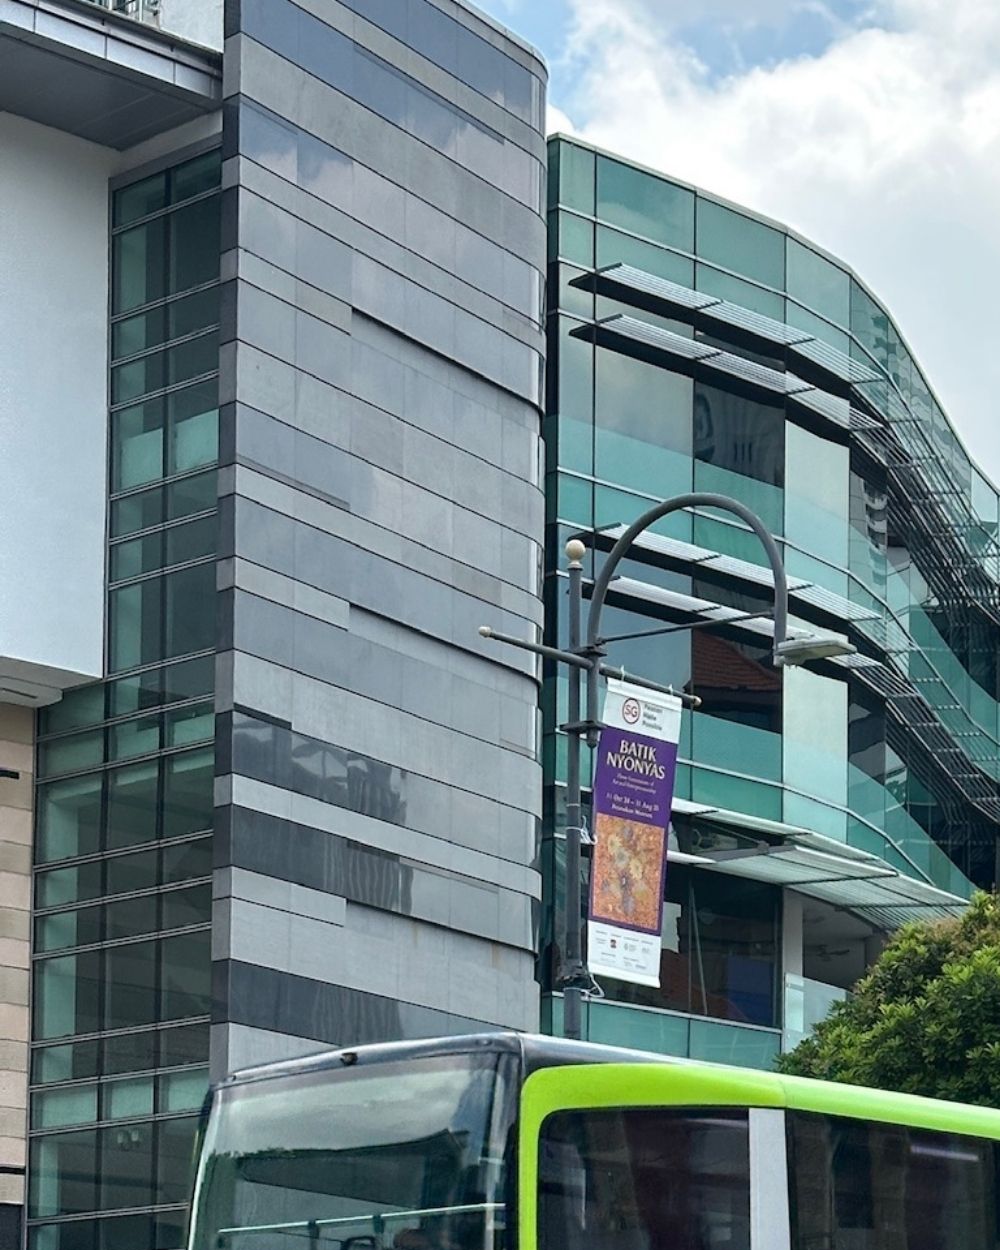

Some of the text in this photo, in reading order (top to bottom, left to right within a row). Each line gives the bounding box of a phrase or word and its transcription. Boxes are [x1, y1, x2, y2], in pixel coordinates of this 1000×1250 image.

[624, 704, 638, 718] SG
[620, 739, 657, 762] BATIK
[606, 751, 666, 780] NYONYAS
